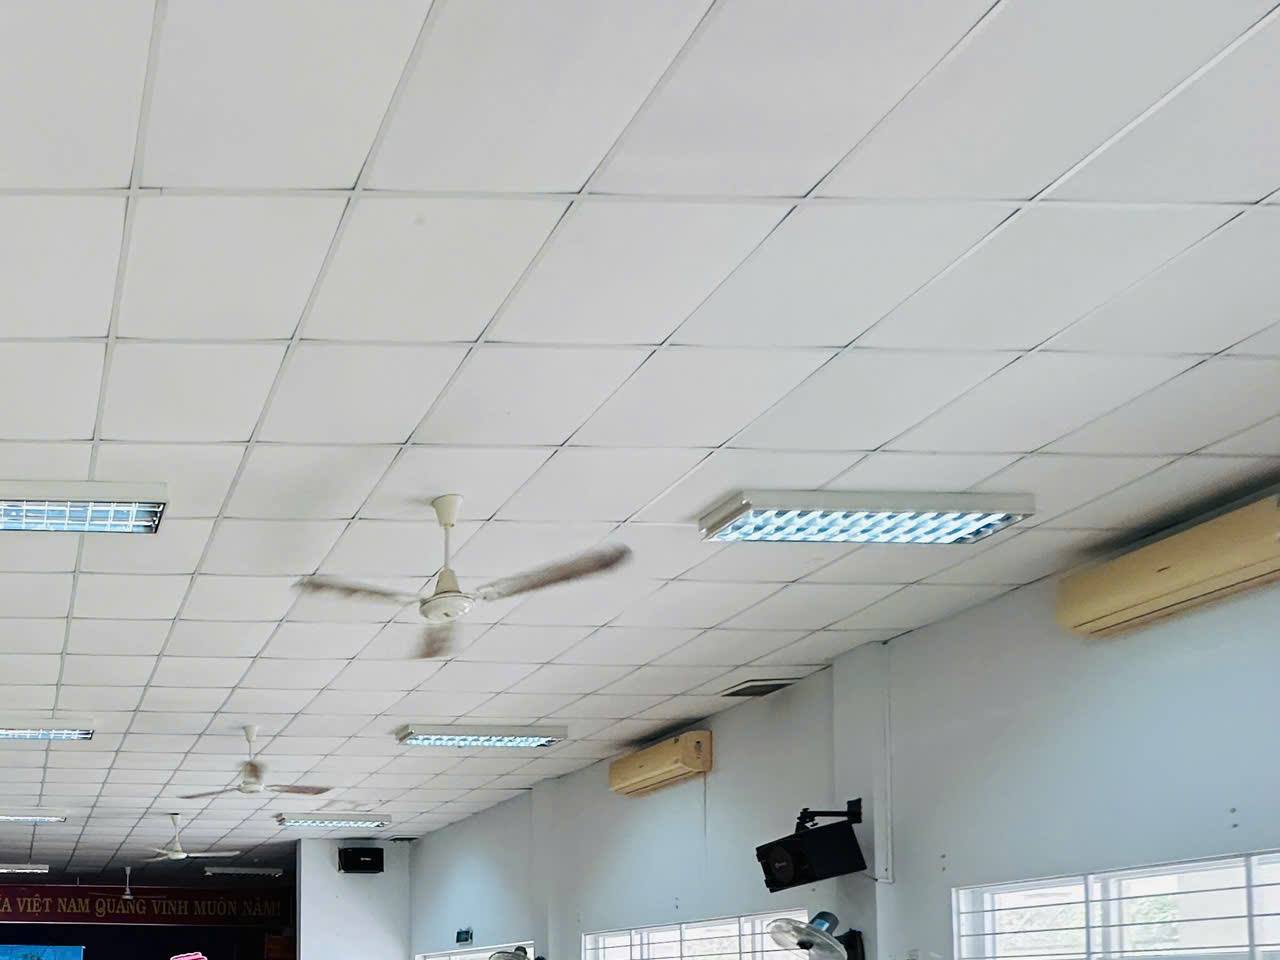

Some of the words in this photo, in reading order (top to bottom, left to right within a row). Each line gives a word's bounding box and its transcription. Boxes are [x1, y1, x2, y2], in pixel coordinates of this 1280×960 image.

[16, 894, 52, 916] VIỆT
[57, 897, 90, 913] NAM
[95, 897, 146, 917] QUANG
[152, 899, 188, 916] VINH
[194, 897, 239, 916] MUÔN
